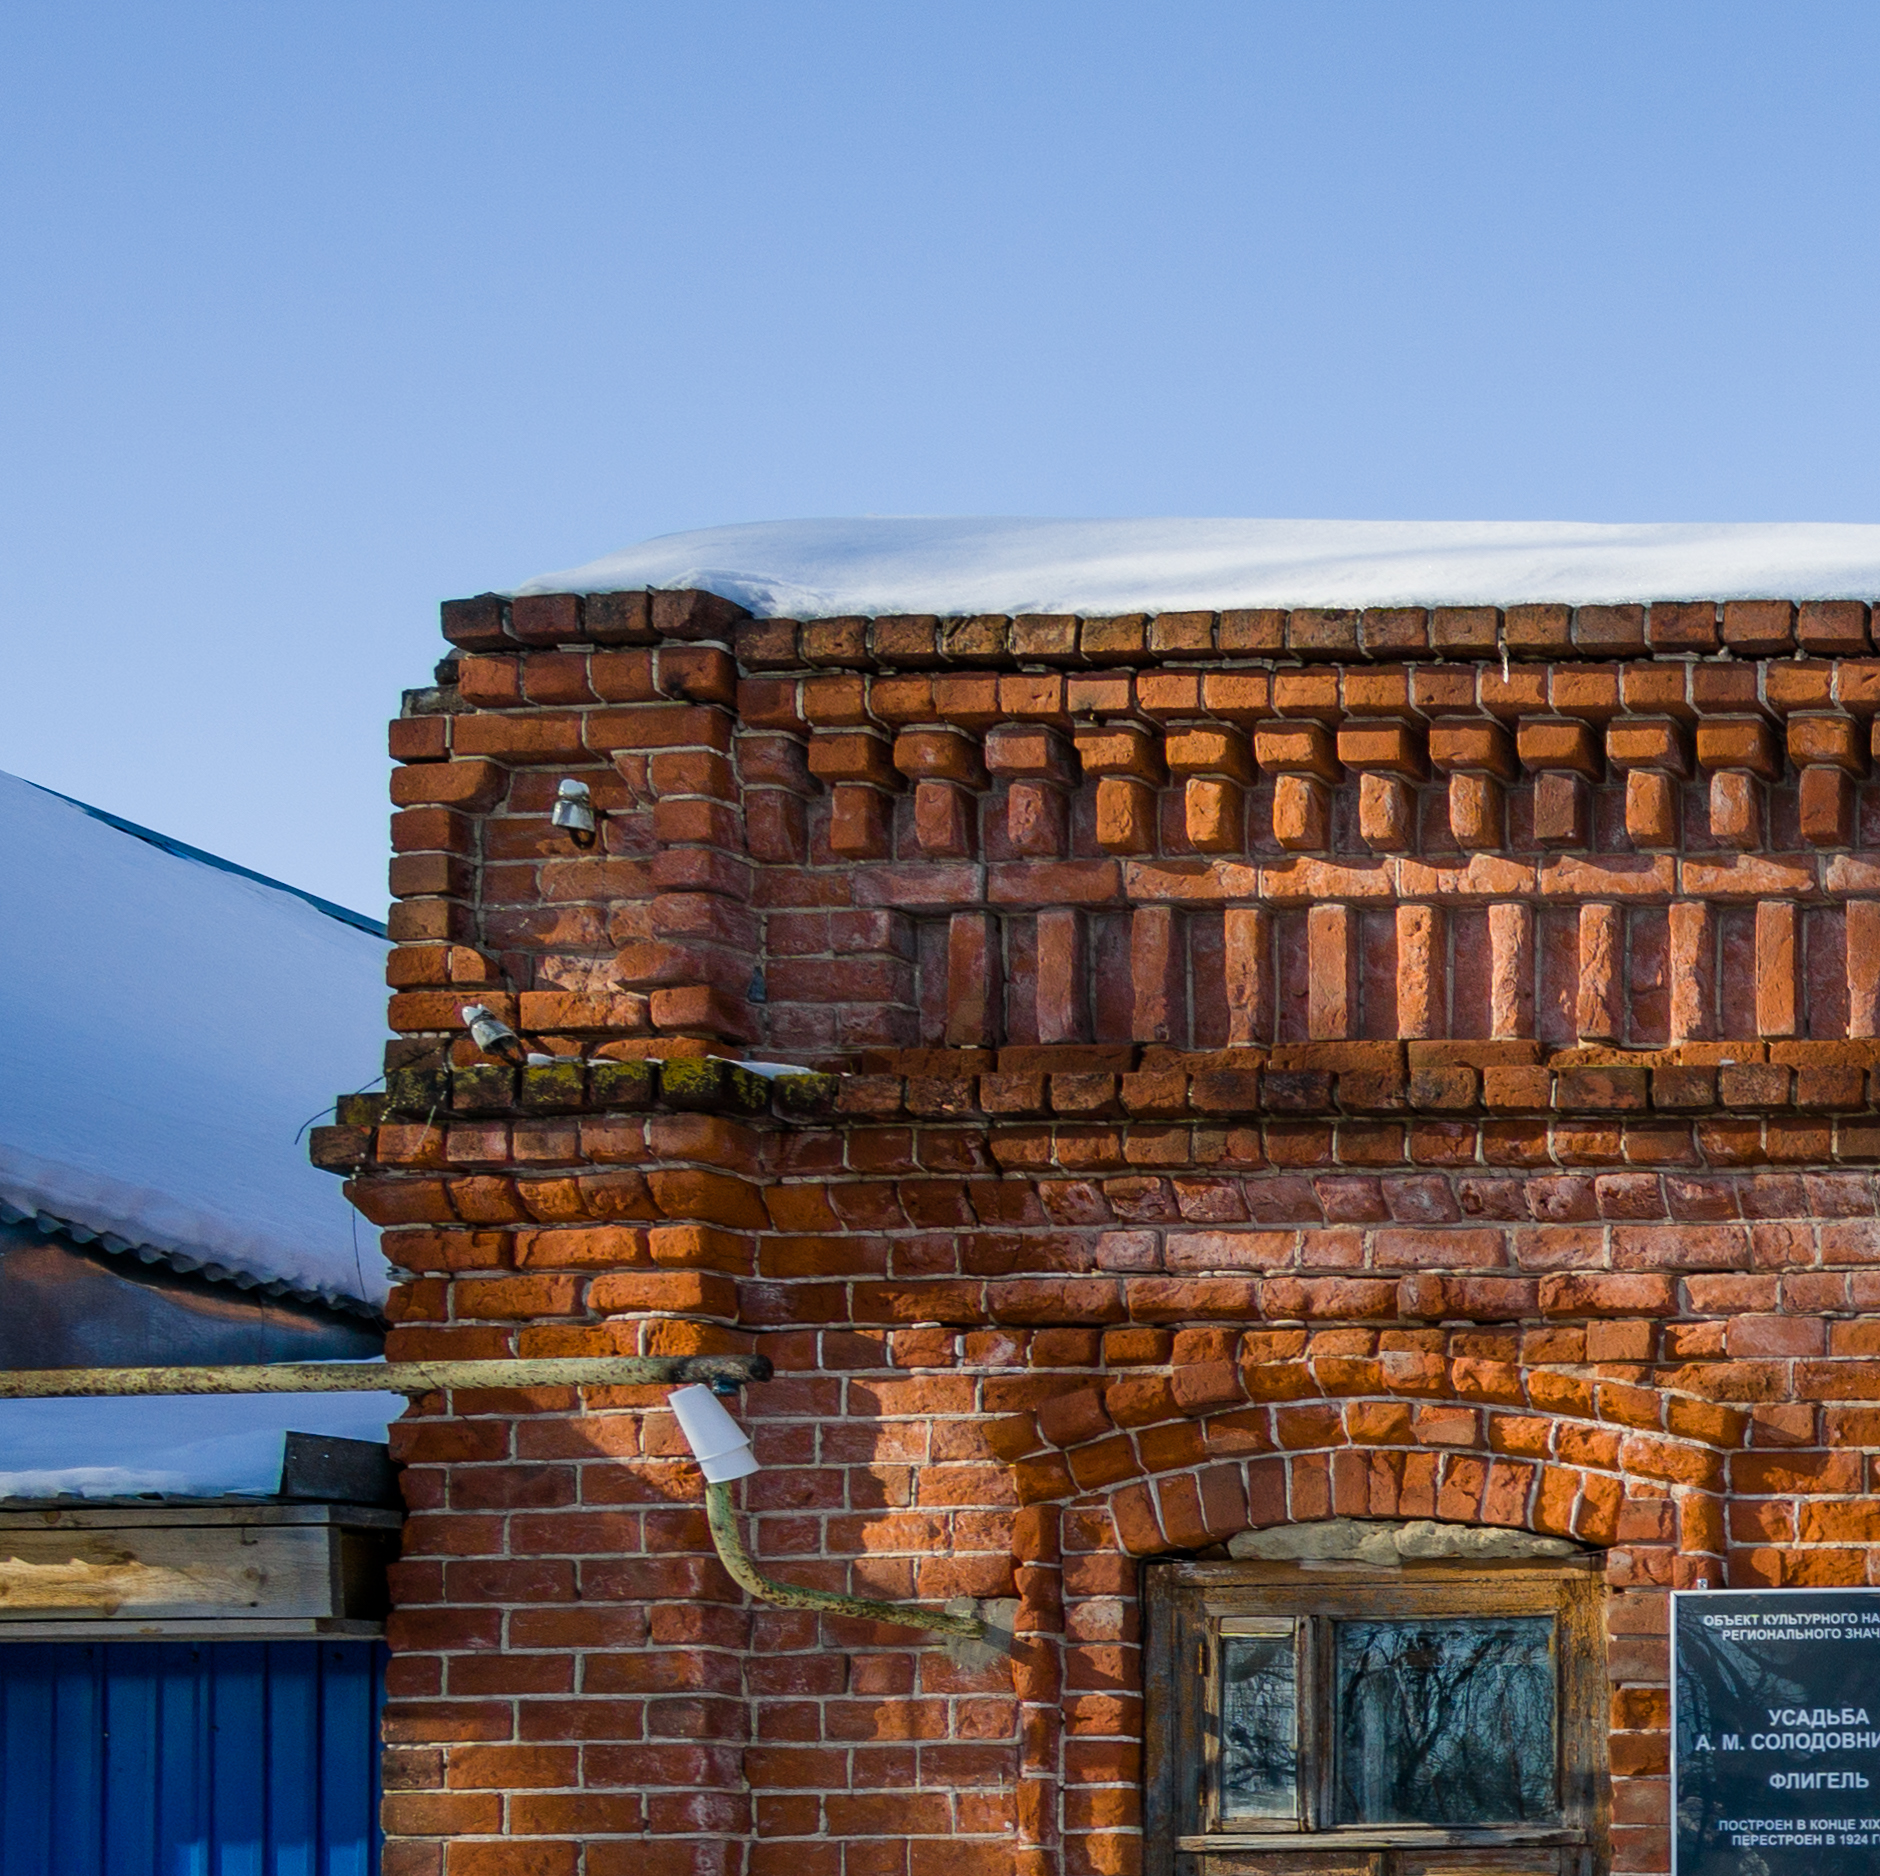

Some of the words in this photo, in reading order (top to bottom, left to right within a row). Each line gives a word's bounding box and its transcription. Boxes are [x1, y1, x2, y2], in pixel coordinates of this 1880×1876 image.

[1703, 1614, 1759, 1626] ОБЪЕКТ
[1762, 1613, 1858, 1626] КУЛЬТУРНОГО
[1722, 1628, 1842, 1641] РЕГИОНАЛЬНОГО
[1768, 1708, 1870, 1729] УСАДЬБА
[1695, 1734, 1715, 1751] А.
[1722, 1734, 1745, 1751] М.
[1769, 1772, 1869, 1789] ФЛИГЕЛЬ
[1718, 1819, 1793, 1831] ПОСТРОЕН
[1796, 1819, 1807, 1830] В
[1810, 1819, 1856, 1832] КОНЦЕ
[1732, 1834, 1822, 1846] ПЕРЕСТРОЕН
[1826, 1834, 1836, 1845] В
[1839, 1834, 1869, 1845] 1924
